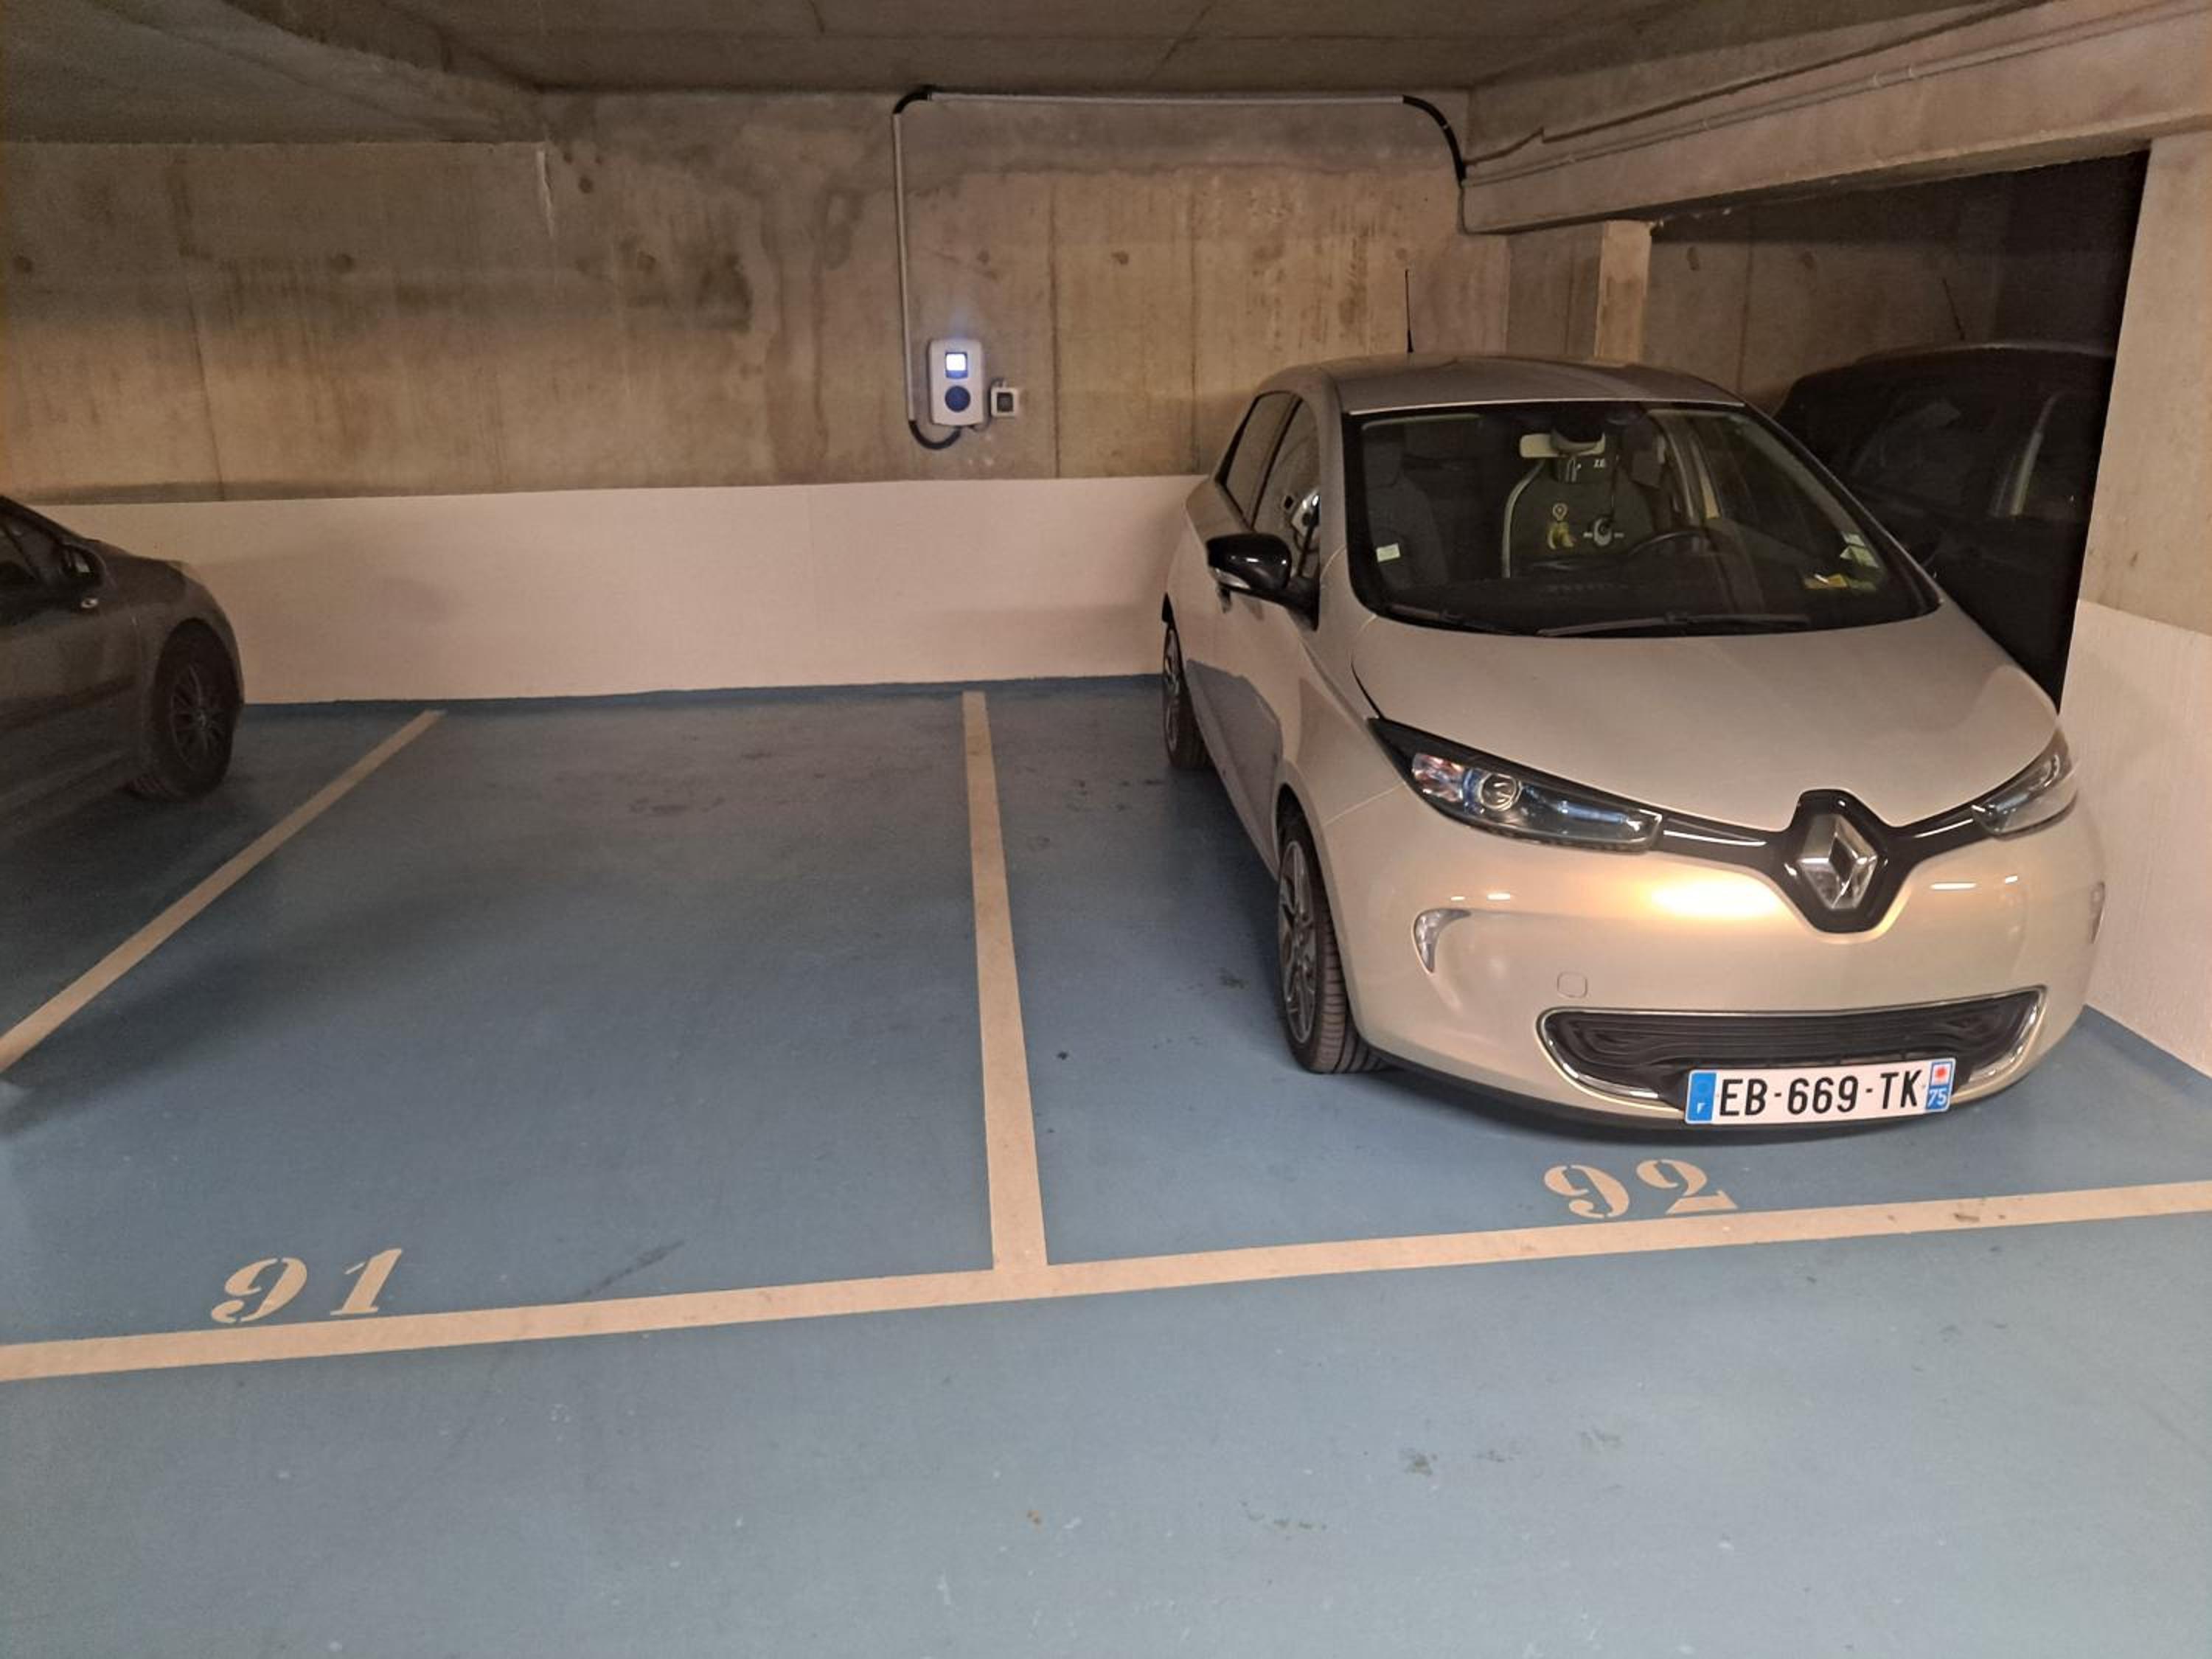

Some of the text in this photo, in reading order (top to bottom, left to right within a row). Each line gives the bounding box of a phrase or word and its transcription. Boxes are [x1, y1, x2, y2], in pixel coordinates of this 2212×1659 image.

[1719, 1070, 1921, 1116] EB-669-TK
[1928, 1088, 1947, 1107] 75
[1544, 1158, 1738, 1218] 92
[211, 1248, 403, 1324] 91
